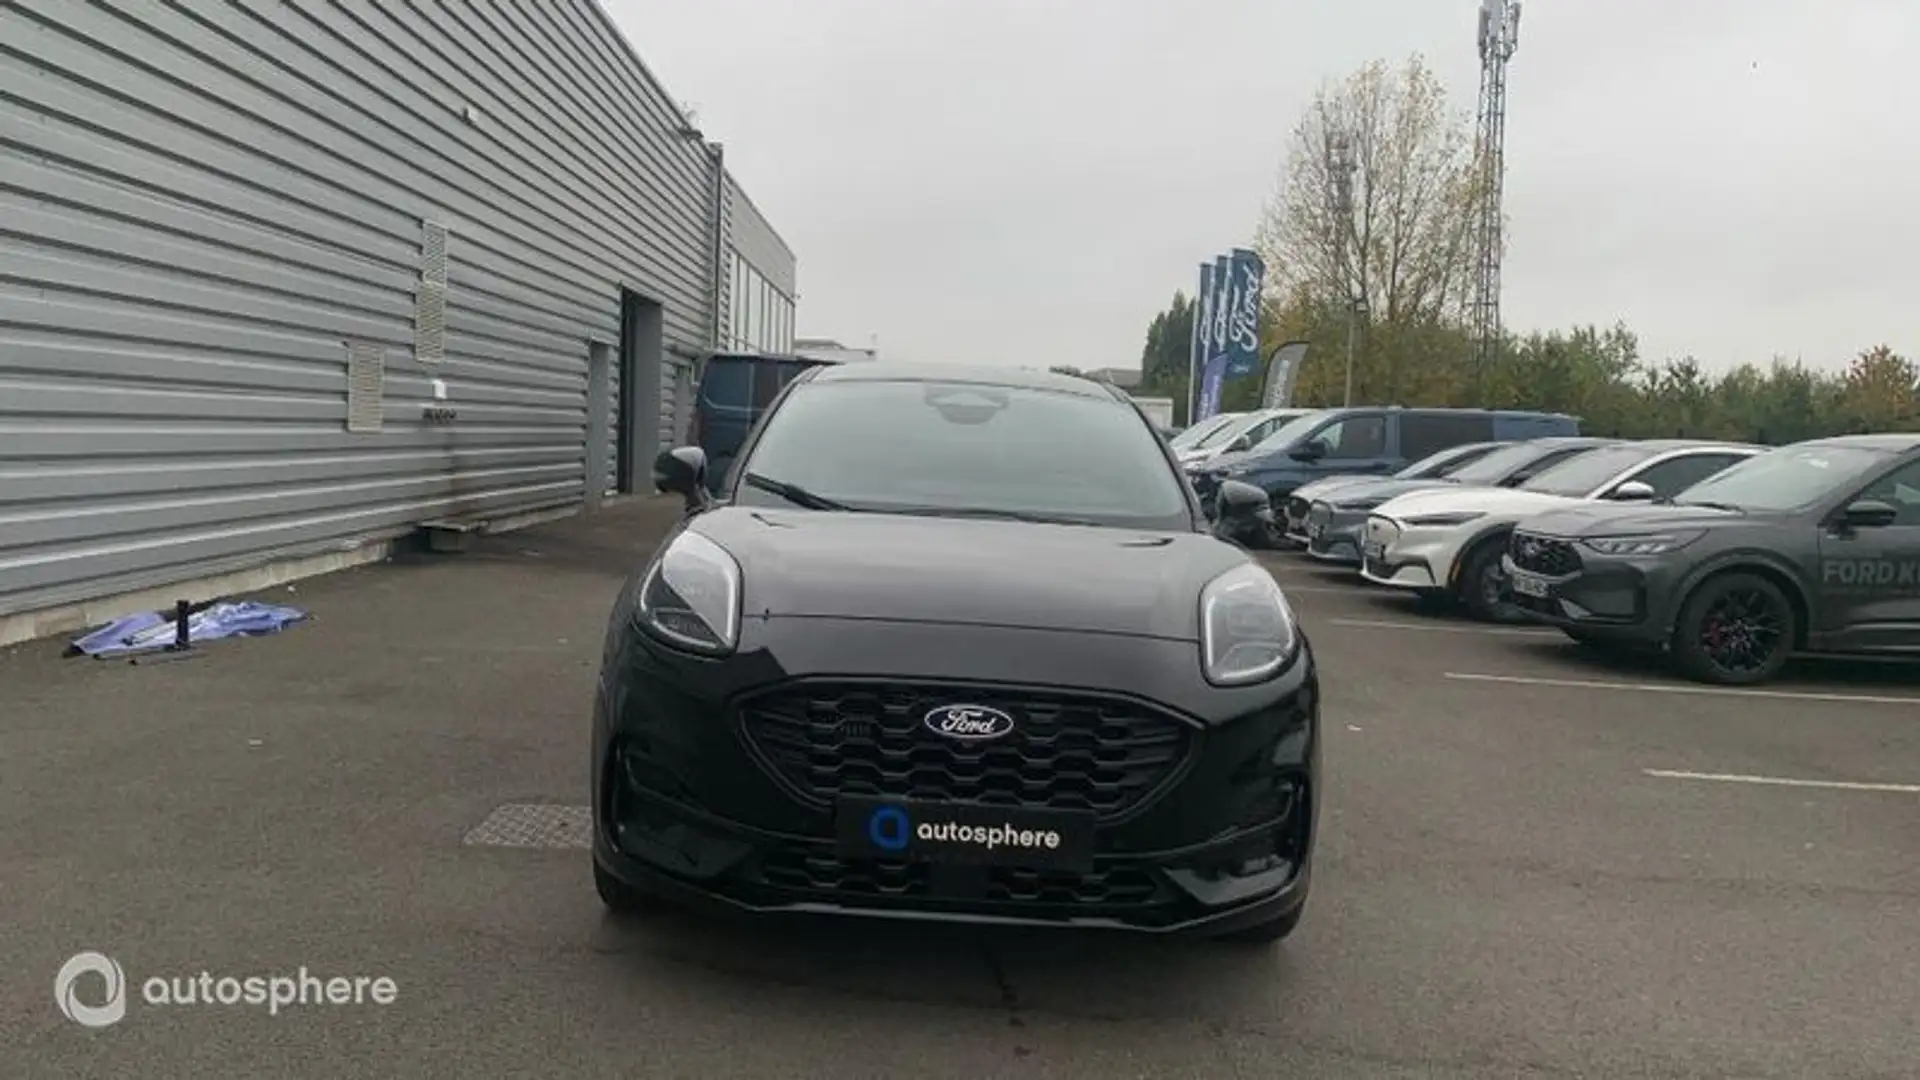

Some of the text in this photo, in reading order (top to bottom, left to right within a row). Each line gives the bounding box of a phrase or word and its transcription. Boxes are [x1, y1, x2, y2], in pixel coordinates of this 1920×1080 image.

[1229, 263, 1259, 352] Ford
[1823, 560, 1920, 585] FORD K
[941, 710, 997, 733] Ford
[917, 822, 1060, 848] autosphere
